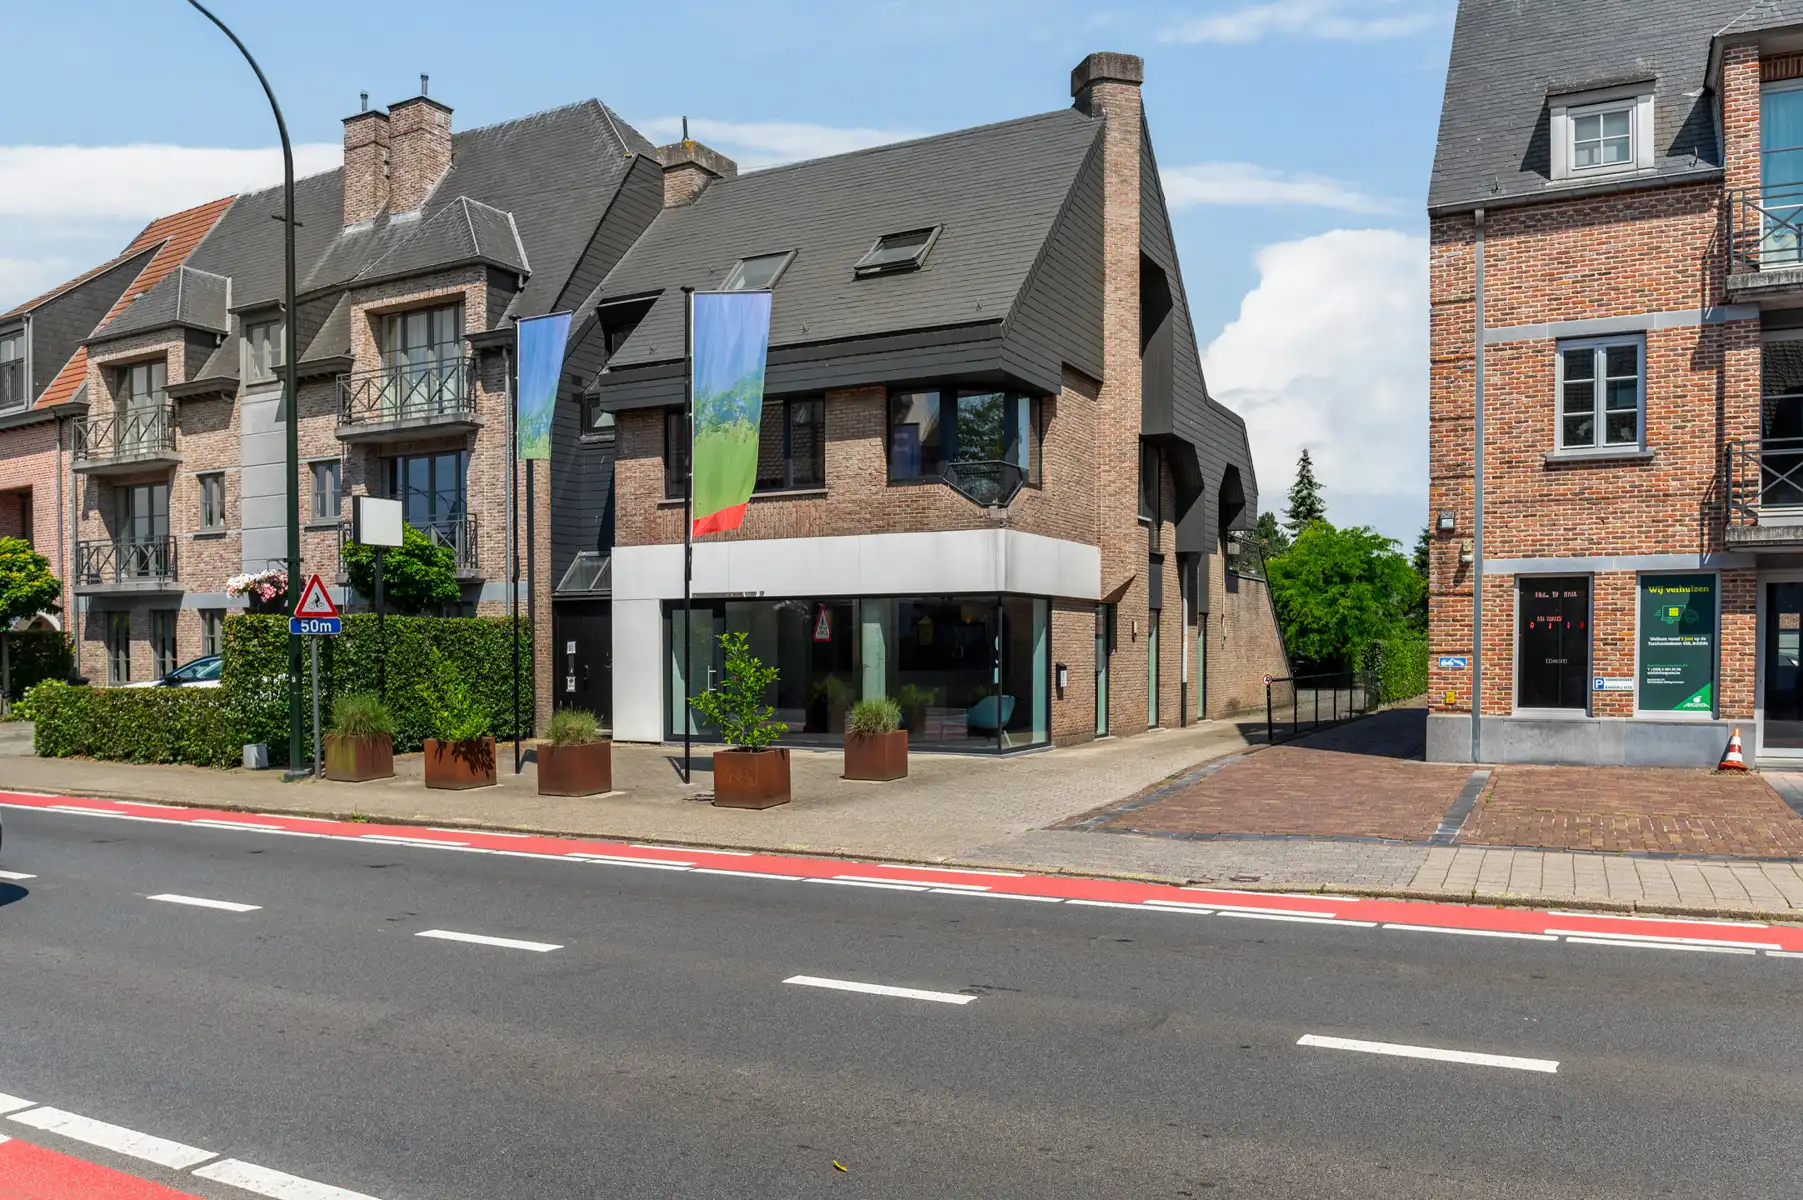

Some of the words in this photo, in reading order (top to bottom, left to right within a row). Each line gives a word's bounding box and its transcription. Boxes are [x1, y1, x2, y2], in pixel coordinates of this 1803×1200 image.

[1648, 585, 1664, 595] Wij
[300, 619, 332, 633] 50m
[1596, 680, 1604, 688] P
